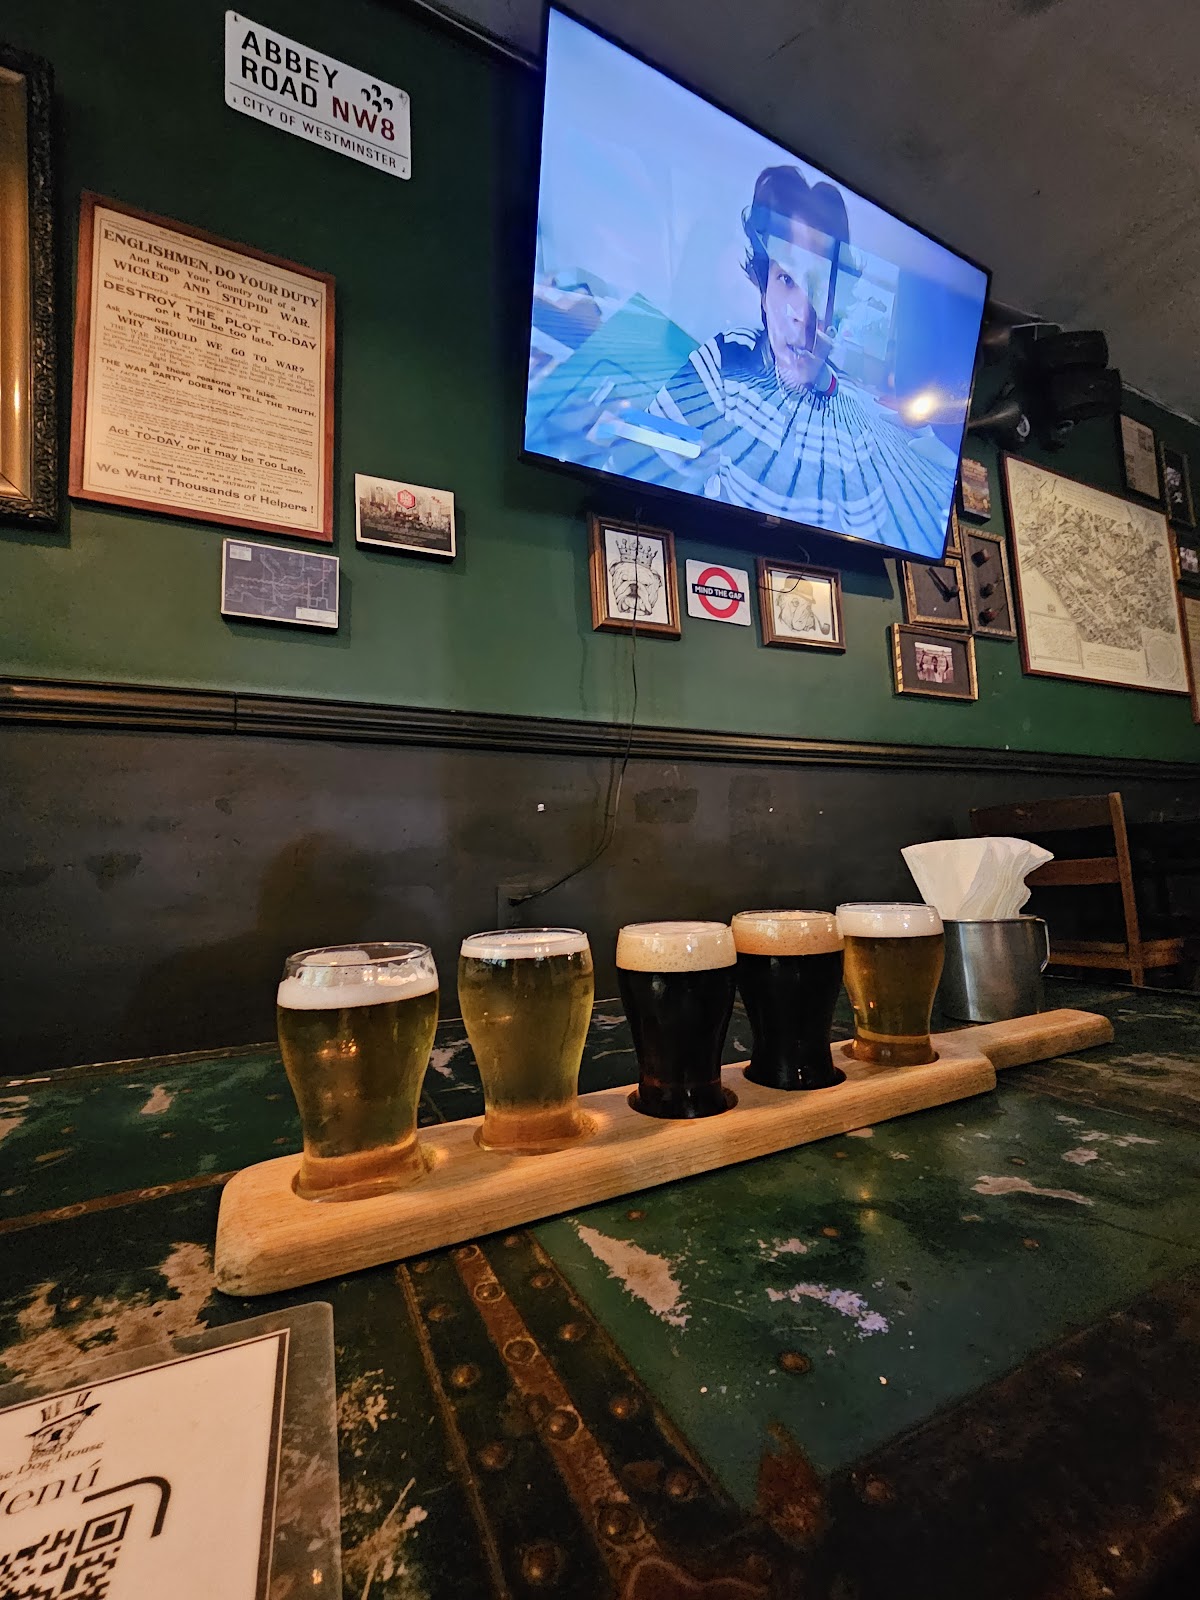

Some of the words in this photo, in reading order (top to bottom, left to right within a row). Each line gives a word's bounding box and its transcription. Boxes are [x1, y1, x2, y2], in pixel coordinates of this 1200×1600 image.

[241, 30, 339, 89] ABBEY
[241, 55, 318, 109] ROAD
[332, 95, 395, 141] NW8
[243, 95, 275, 117] CITY
[280, 111, 296, 126] OF
[302, 120, 396, 169] WESTMINSTER
[104, 228, 213, 275] ENGLISHMEN,
[215, 265, 236, 281] DO
[239, 273, 278, 295] YOUR
[281, 287, 319, 309] DUTY
[113, 258, 169, 284] WICKED
[183, 280, 210, 297] AND
[222, 293, 268, 315] STUPID
[280, 312, 310, 328] WAR.
[129, 252, 150, 265] And
[156, 261, 180, 276] Keep
[187, 271, 210, 285] Your
[216, 280, 252, 299] Country
[257, 294, 273, 305] Out
[278, 300, 286, 309] of
[103, 279, 177, 310] DESTROY
[186, 304, 216, 321] THE
[225, 316, 261, 335] PLOT
[268, 329, 317, 352] TO-DAY
[106, 303, 121, 313] Ask
[155, 306, 169, 316] or
[173, 311, 181, 319] it
[187, 315, 206, 327] will
[211, 322, 224, 332] be
[230, 328, 247, 339] too
[252, 335, 274, 347] late.
[117, 314, 145, 329] WHY
[154, 325, 197, 344] SHOULD
[206, 340, 223, 351] WE
[231, 347, 245, 357] GO
[253, 353, 267, 364] TO
[276, 360, 305, 374] WAR?
[100, 356, 121, 367] THE
[124, 363, 147, 374] WAR
[152, 370, 184, 383] PARTY
[188, 379, 213, 391] DOES
[218, 387, 237, 397] NOT
[241, 393, 262, 404] TELL
[266, 400, 283, 409] THE
[286, 405, 316, 418] TRUTH.
[149, 361, 160, 369] All
[166, 366, 191, 377] these
[197, 375, 231, 388] reasons
[236, 385, 251, 393] are
[256, 390, 277, 400] false.
[108, 425, 130, 436] Act
[134, 430, 184, 448] TO-DAY,
[187, 444, 200, 452] or
[203, 446, 213, 455] it
[214, 449, 238, 461] may
[241, 455, 254, 464] be
[257, 458, 277, 469] Too
[281, 463, 306, 475] Late.
[96, 462, 120, 475] We
[124, 468, 163, 484] Want
[166, 476, 240, 499] Thousands
[243, 492, 257, 502] of
[260, 495, 307, 514] Helpers
[694, 585, 714, 595] MIND
[714, 588, 728, 597] THE
[728, 591, 743, 600] GAP
[0, 1458, 102, 1515] enú
[17, 1459, 50, 1475] Dog
[56, 1442, 104, 1463] House
